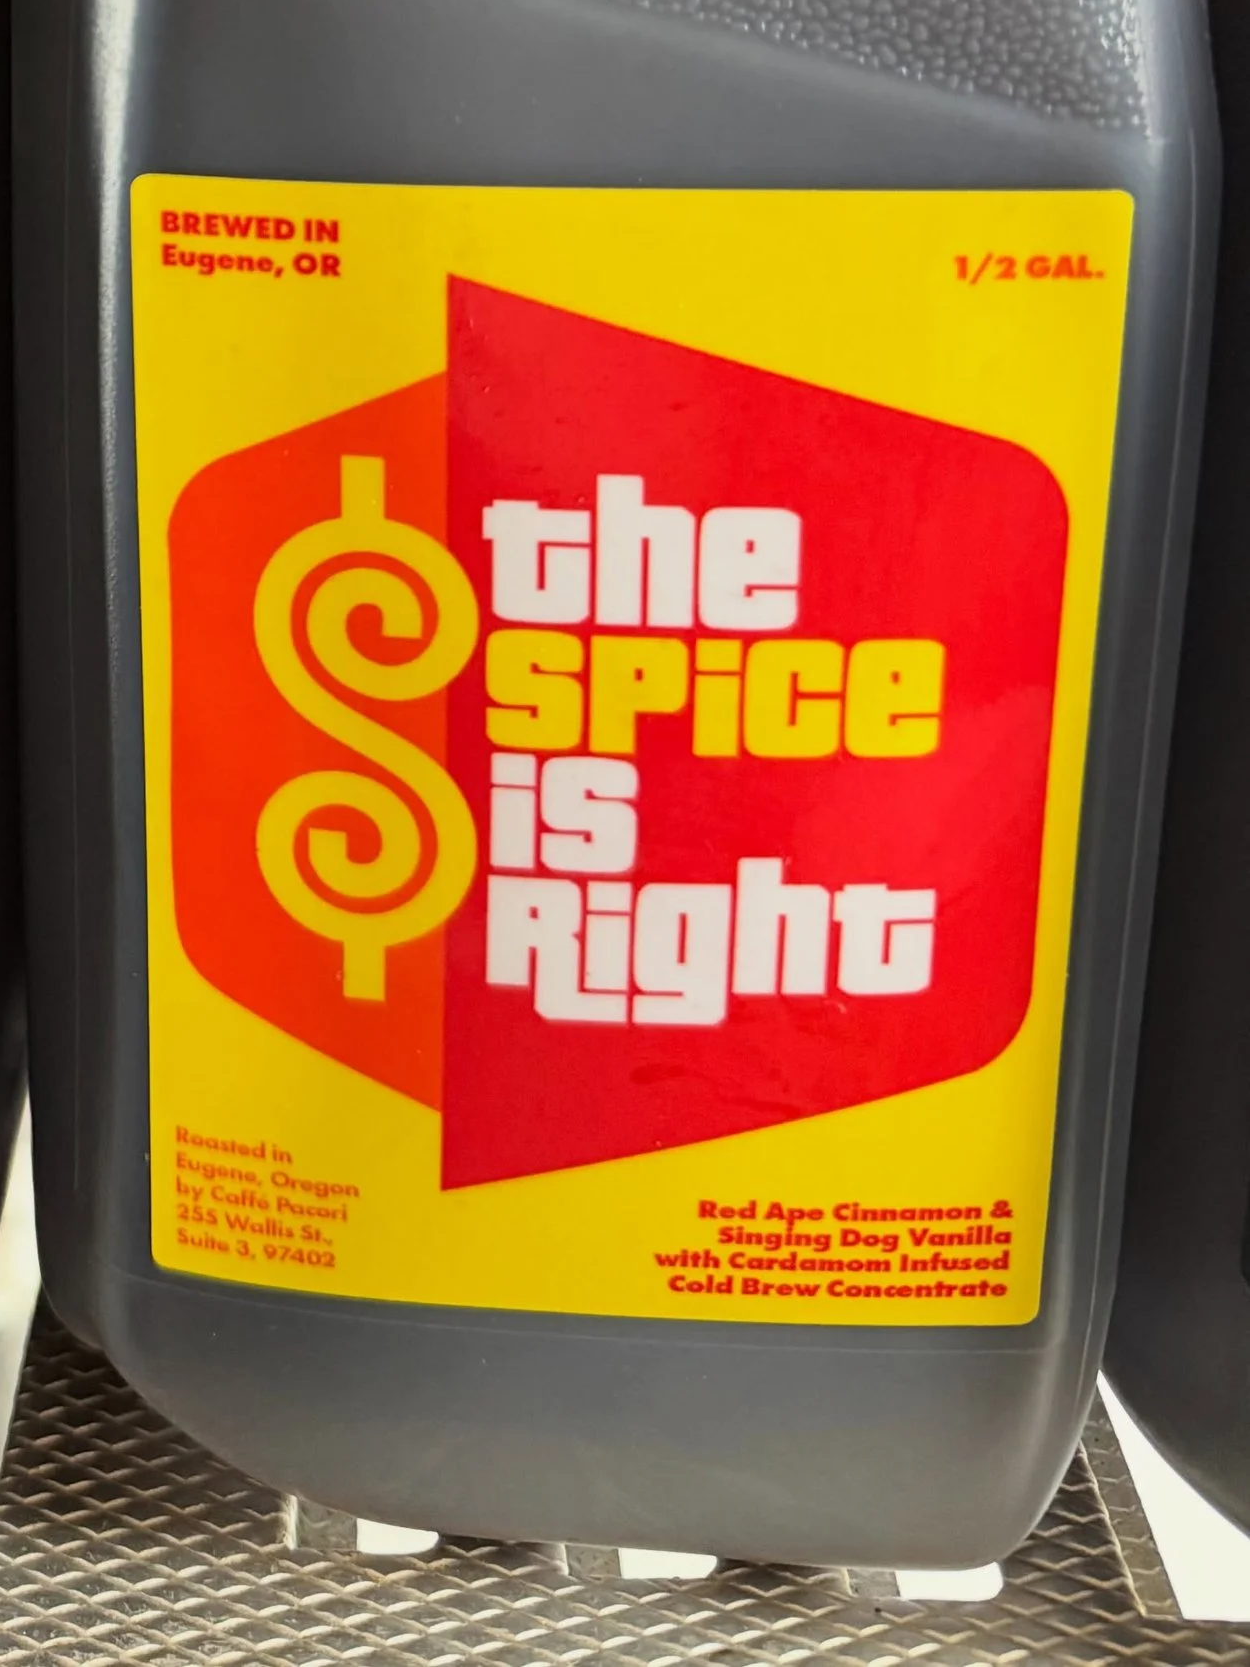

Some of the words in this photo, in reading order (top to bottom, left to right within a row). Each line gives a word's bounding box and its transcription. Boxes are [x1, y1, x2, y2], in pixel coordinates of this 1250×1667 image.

[160, 210, 295, 240] BREWED
[304, 219, 340, 243] IN
[161, 244, 283, 278] Eugene,
[292, 253, 340, 276] OR
[954, 252, 1018, 286] 1/2
[1025, 255, 1105, 280] GAL.
[482, 474, 802, 630] the
[490, 752, 639, 874] is
[486, 857, 936, 1026] Right
[176, 1125, 266, 1160] Roasted
[272, 1144, 292, 1164] in
[176, 1152, 262, 1186] Eugene,
[270, 1171, 360, 1198] Oregon
[176, 1175, 203, 1201] by
[276, 1196, 347, 1222] Pacori
[697, 1200, 756, 1221] Red
[764, 1202, 824, 1230] Ape
[832, 1203, 982, 1221] Cinnamon
[989, 1200, 1013, 1219] &
[176, 1204, 217, 1225] 255
[225, 1212, 294, 1238] Wallis
[177, 1228, 229, 1252] Suite
[236, 1240, 256, 1259] 3,
[263, 1243, 336, 1268] 97402
[718, 1226, 831, 1253] Singing
[840, 1229, 899, 1252] Dog
[908, 1225, 1012, 1247] Vanilla
[655, 1249, 720, 1270] with
[728, 1251, 890, 1272] Cardamom
[899, 1251, 1009, 1273] Infused
[668, 1275, 733, 1295] Cold
[742, 1277, 820, 1297] Brew
[827, 1280, 1007, 1299] Concentrate
